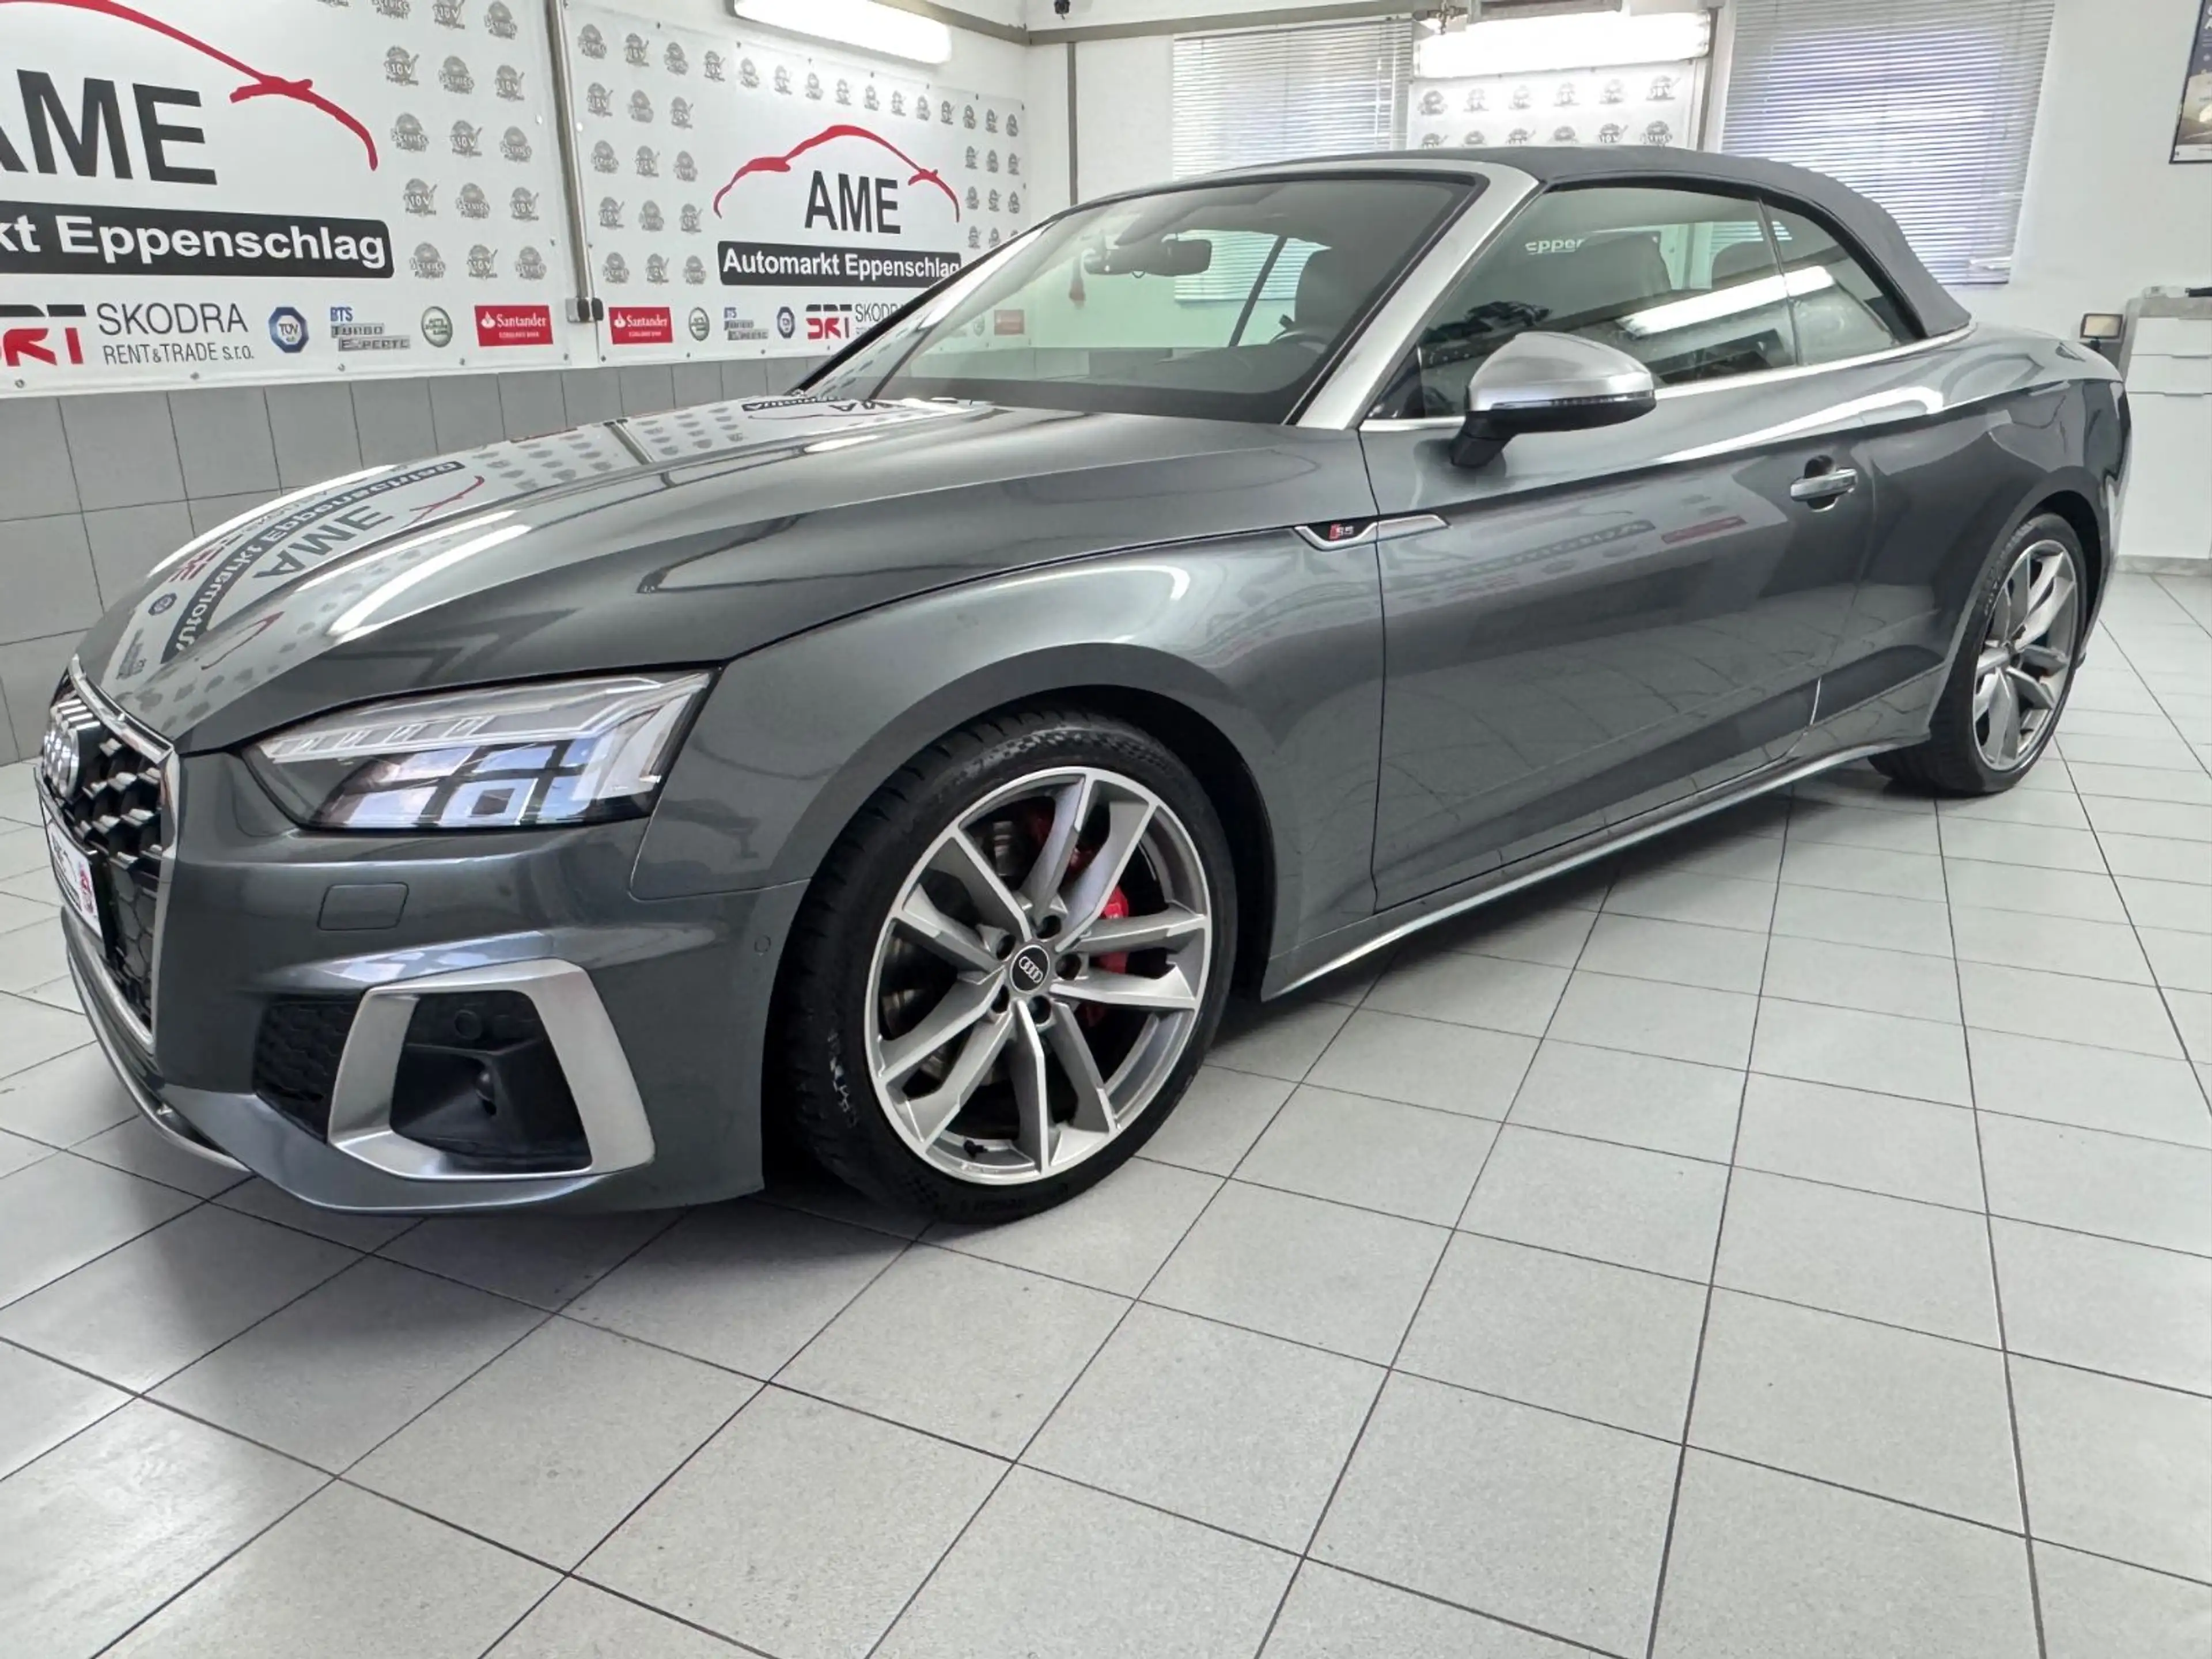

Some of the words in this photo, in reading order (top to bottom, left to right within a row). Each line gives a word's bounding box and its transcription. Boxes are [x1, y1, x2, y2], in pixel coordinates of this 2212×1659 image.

[805, 170, 901, 234] AME
[55, 215, 385, 269] Eppenschlag
[722, 248, 840, 276] Automarkt
[97, 303, 248, 335] SKODRA
[330, 306, 353, 322] BTS
[496, 312, 547, 328] Santander
[626, 313, 668, 328] Santander
[103, 342, 218, 365] RENT&TRADE
[223, 345, 255, 360] s.r.o.
